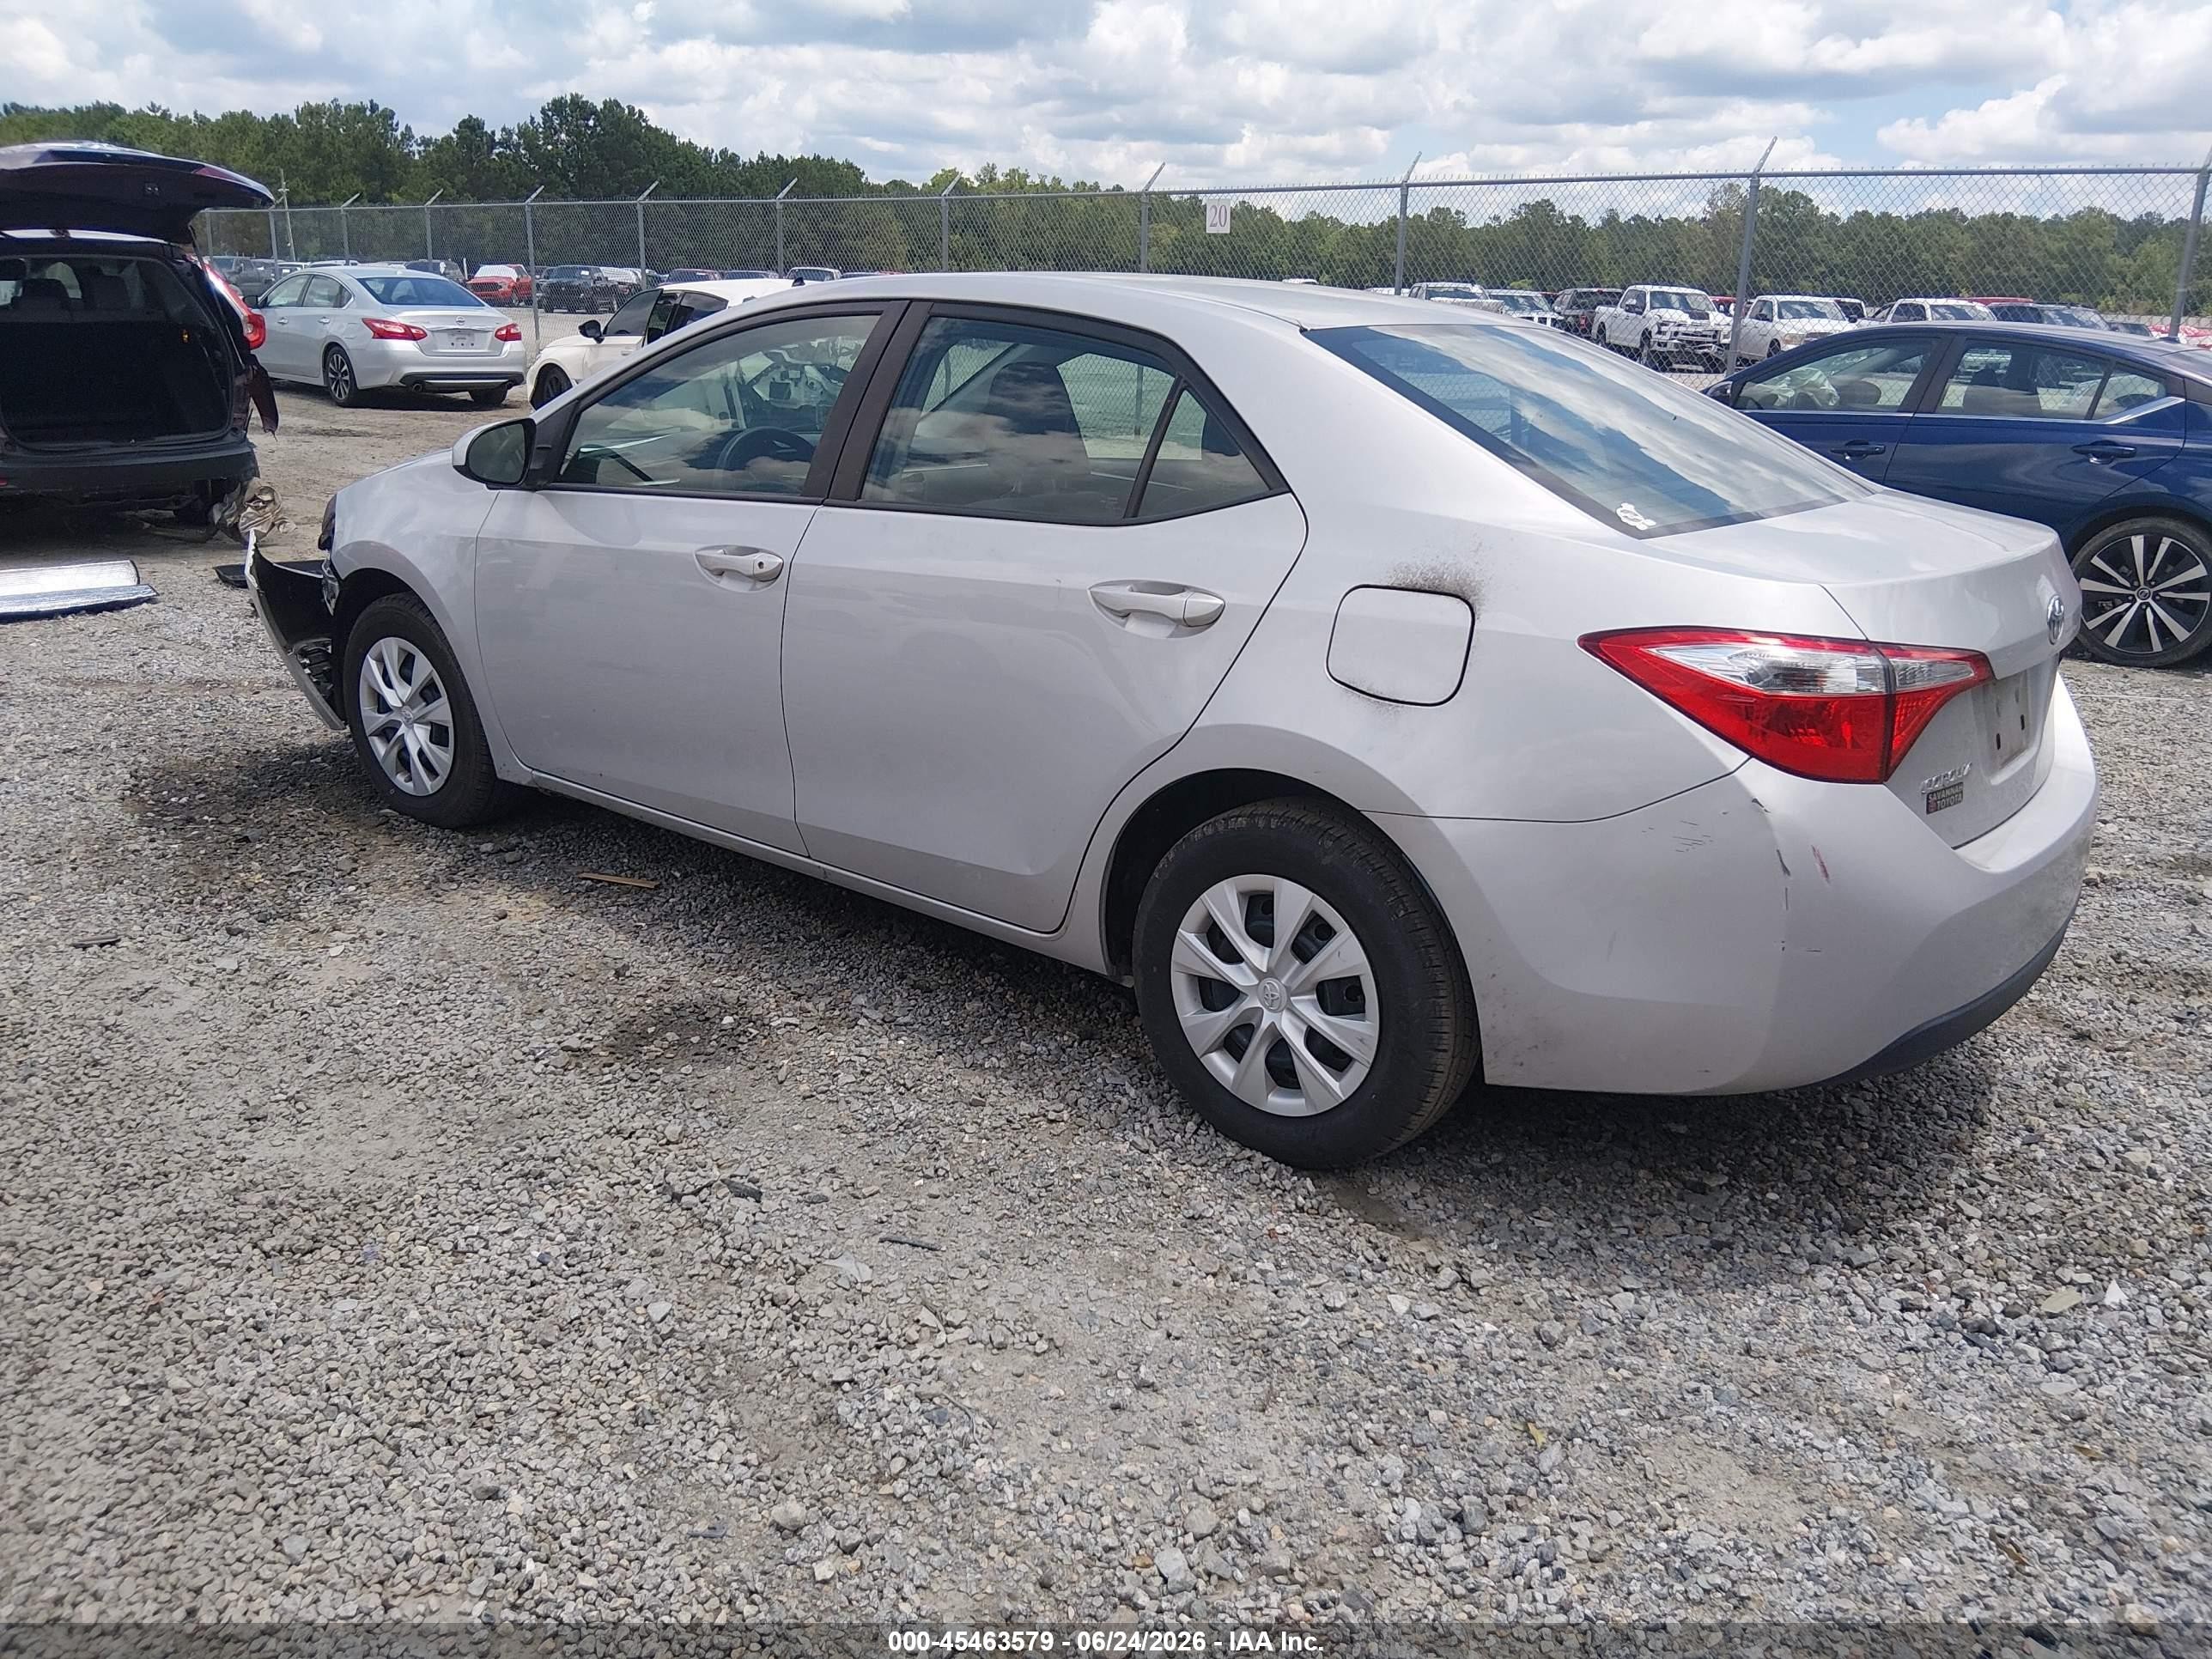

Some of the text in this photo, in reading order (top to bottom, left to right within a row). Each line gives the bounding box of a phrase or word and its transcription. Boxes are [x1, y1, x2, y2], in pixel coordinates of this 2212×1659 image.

[1209, 204, 1228, 228] 20
[1928, 783, 1964, 800] SAVANNAH
[1936, 793, 1963, 811] TOYOTA
